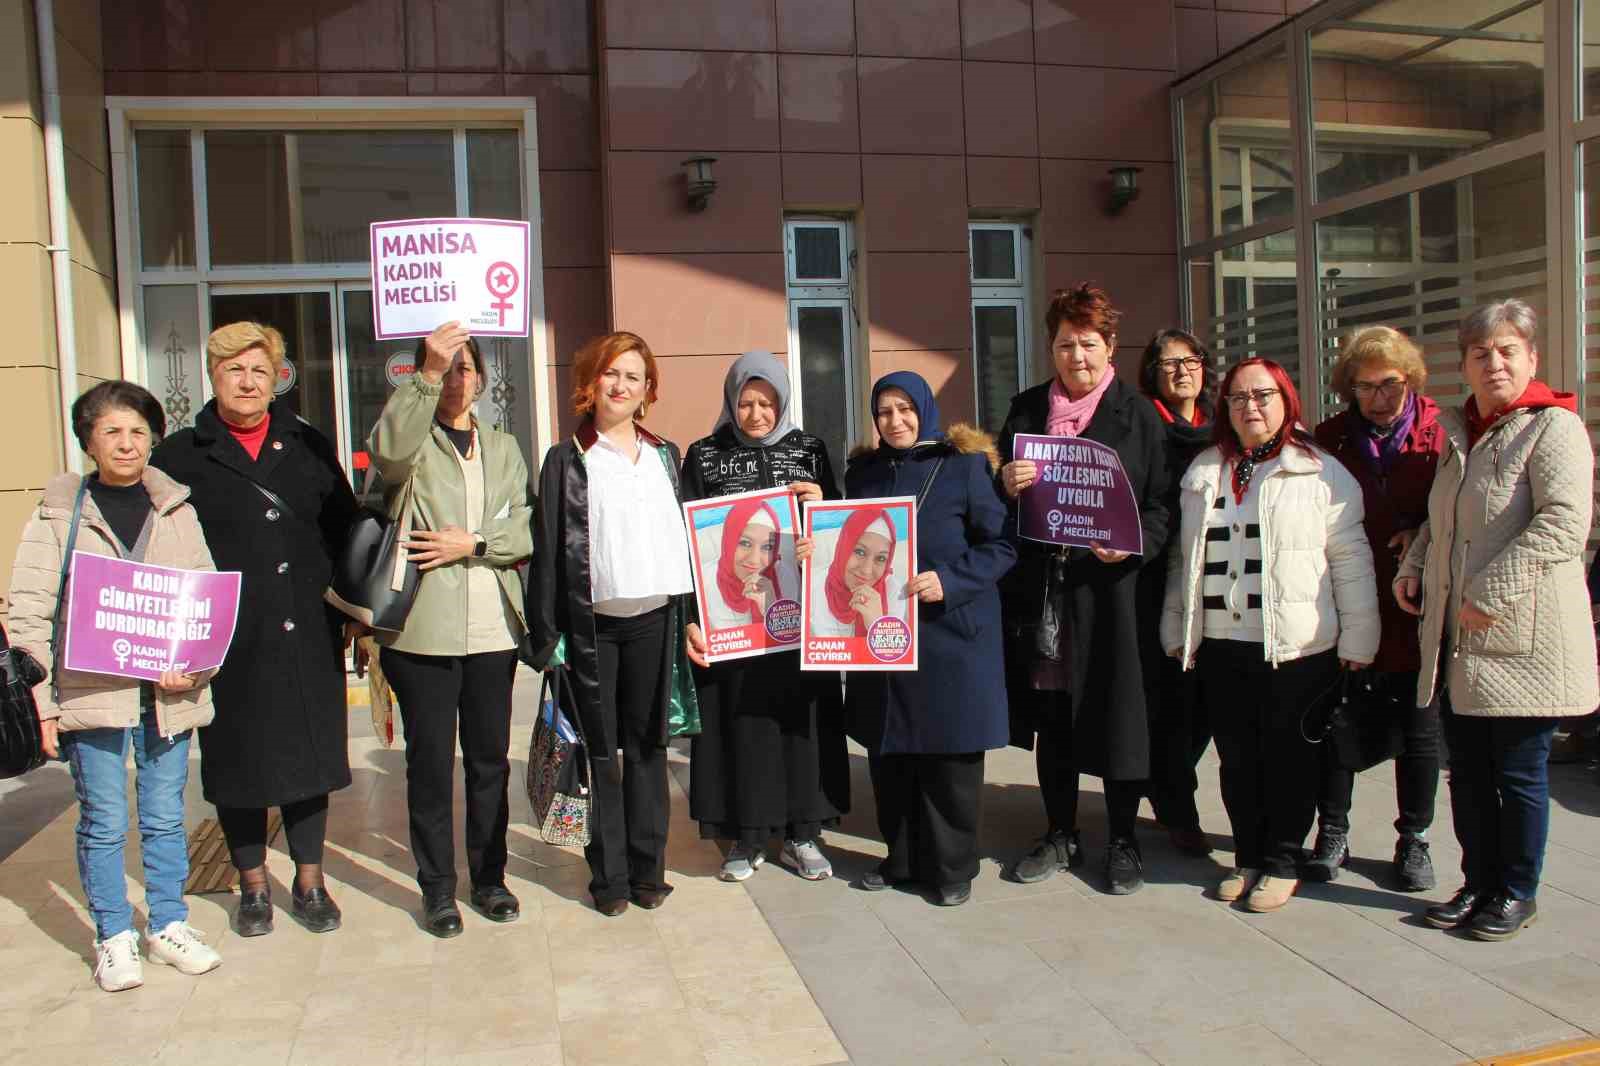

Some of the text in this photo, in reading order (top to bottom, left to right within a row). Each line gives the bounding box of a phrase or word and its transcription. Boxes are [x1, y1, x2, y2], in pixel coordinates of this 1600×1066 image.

[382, 227, 477, 258] MANİSA
[383, 261, 442, 282] KADIN
[384, 281, 457, 306] MECLİSİ
[1023, 442, 1092, 463] ANAYASAYI
[1043, 462, 1115, 488] SÖZLEŞMEYİ
[1057, 487, 1104, 508] UYGULA
[1064, 514, 1094, 526] KADIN
[1063, 526, 1111, 540] MECLİSLERİ
[133, 571, 179, 594] KADIN
[95, 611, 212, 640] DURDURACAĞIZ
[710, 630, 745, 642] CANAN
[132, 644, 167, 658] KADIN
[711, 639, 752, 655] ÇEVİREN
[808, 641, 846, 650] CANAN
[808, 649, 853, 663] ÇEVİREN
